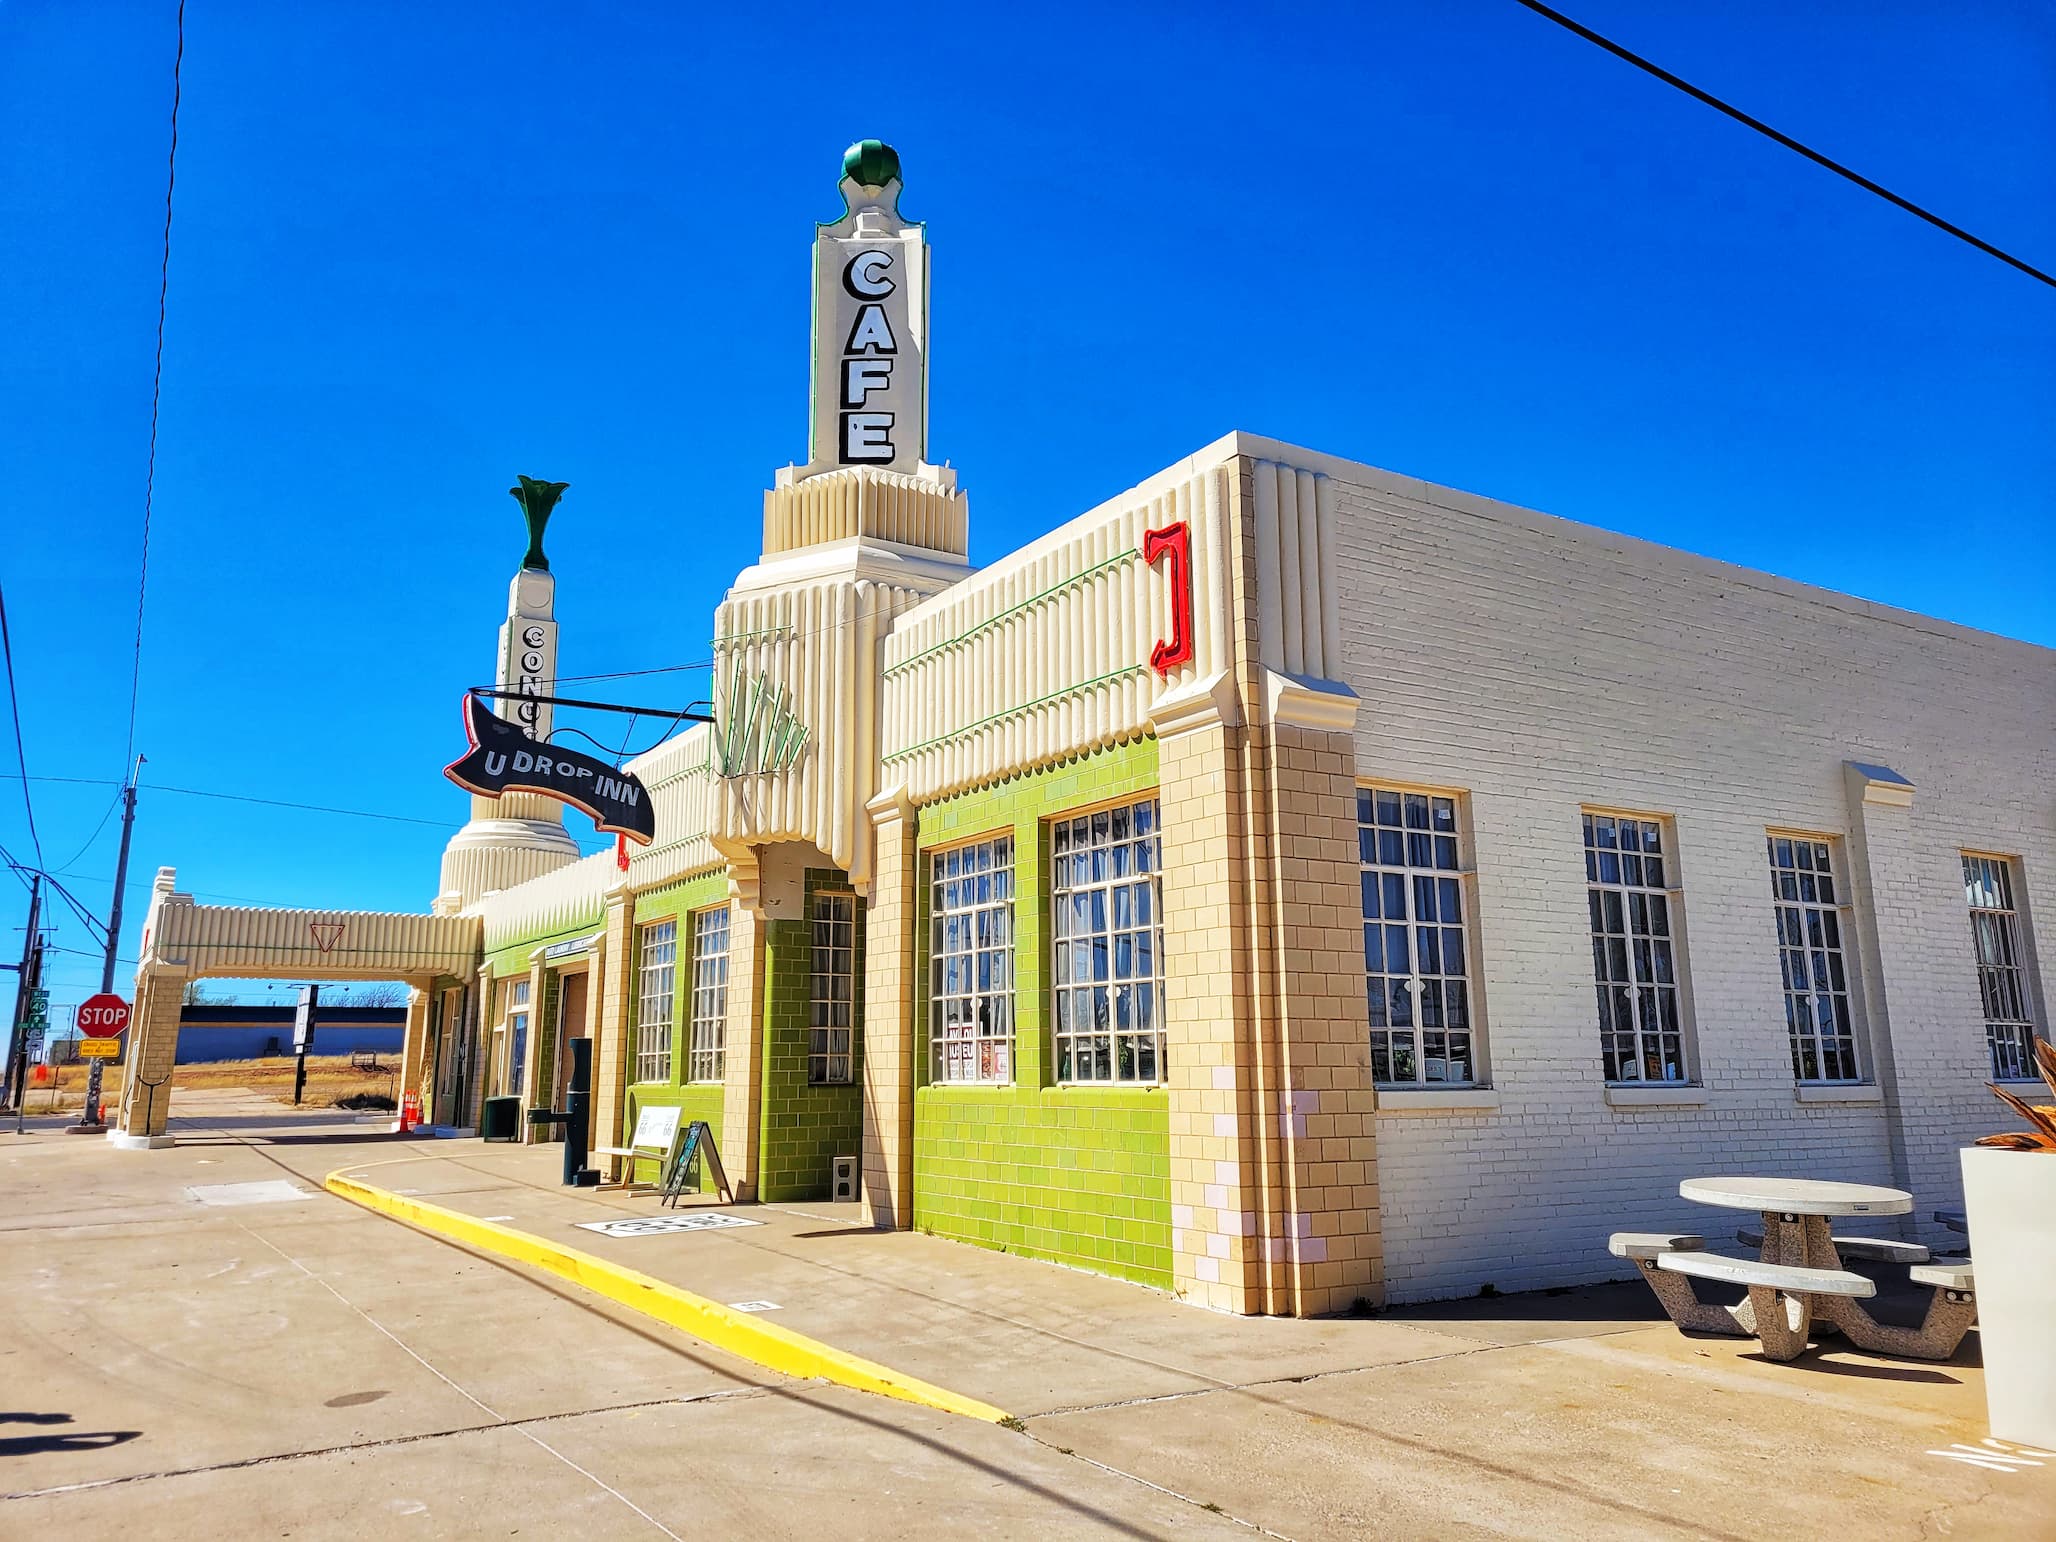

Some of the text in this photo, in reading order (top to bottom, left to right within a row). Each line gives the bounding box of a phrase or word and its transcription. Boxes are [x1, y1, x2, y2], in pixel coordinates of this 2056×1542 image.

[839, 250, 898, 465] CAFE
[485, 750, 640, 807] U DROP INN
[81, 1008, 127, 1025] STOP
